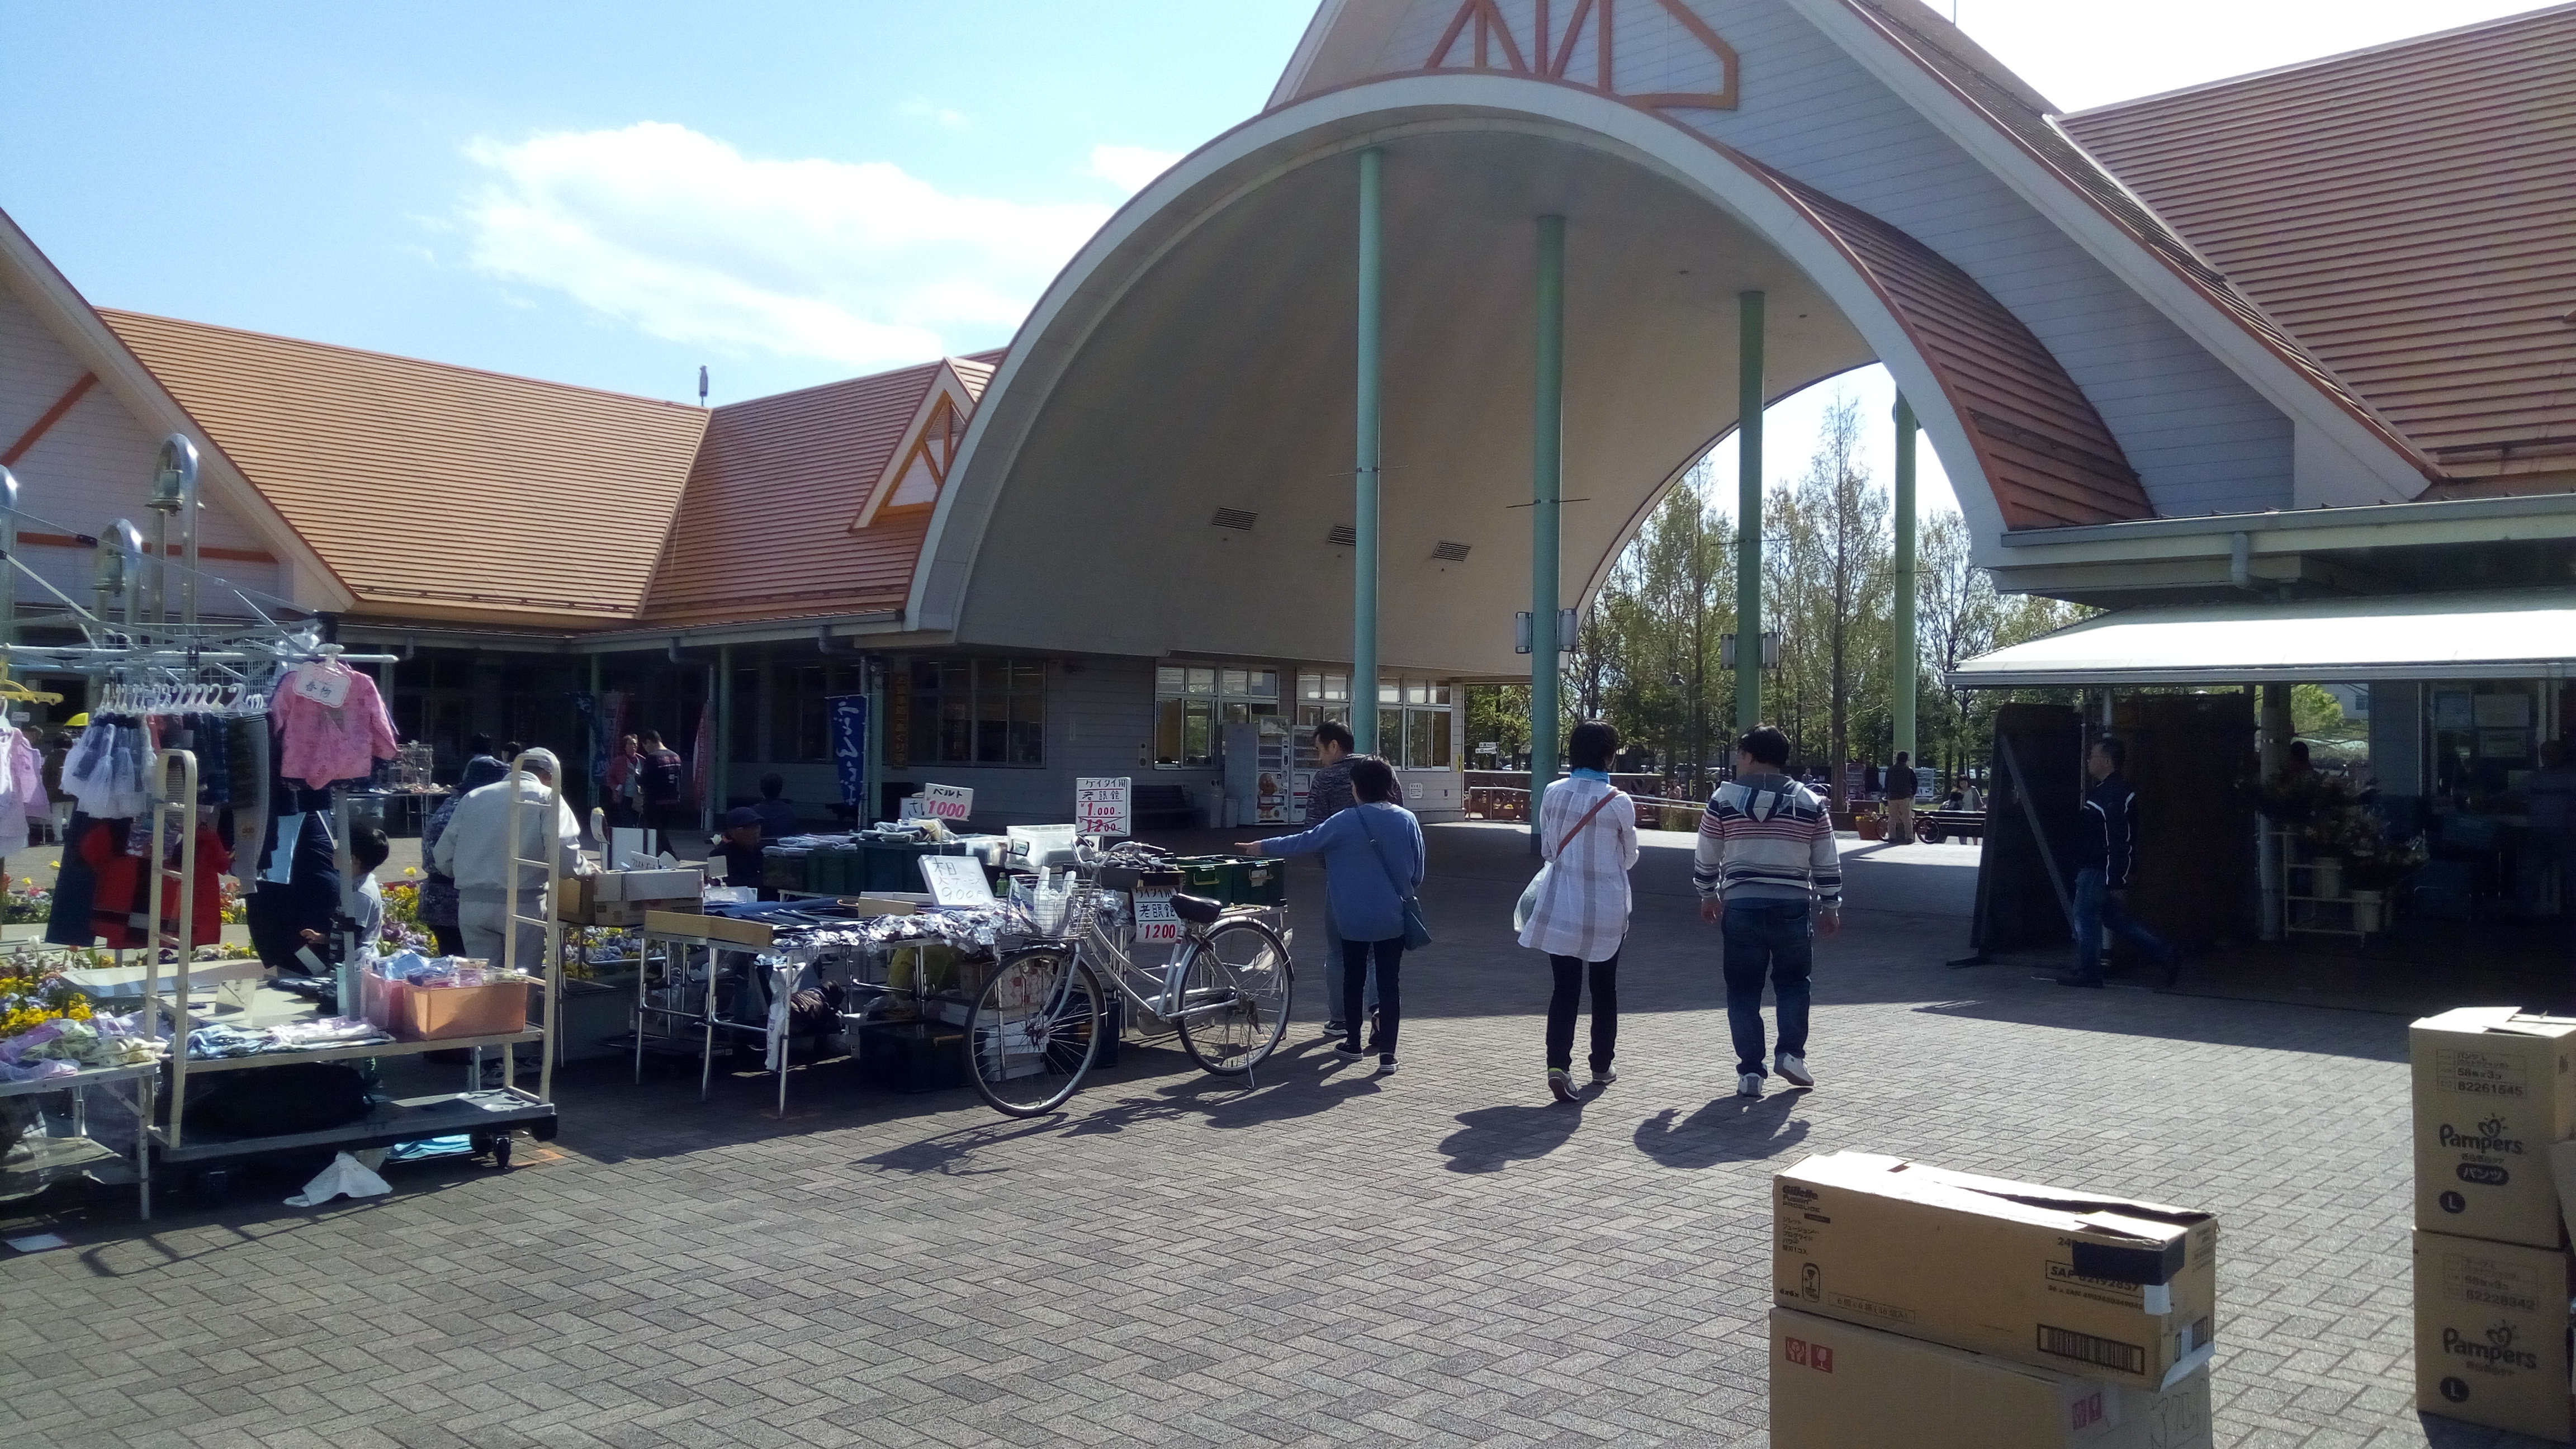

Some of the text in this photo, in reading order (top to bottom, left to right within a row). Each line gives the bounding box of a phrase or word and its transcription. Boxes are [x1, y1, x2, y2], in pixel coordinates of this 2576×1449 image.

[932, 788, 963, 798] ベルト
[2439, 1124, 2524, 1156] Pampers
[2463, 1167, 2502, 1181] パンツ
[1782, 1185, 1819, 1200] Gillette
[2448, 1194, 2457, 1209] L
[2050, 1266, 2076, 1278] SAP
[2066, 1289, 2081, 1298] EAN
[2442, 1327, 2538, 1370] Pampers
[2450, 1381, 2460, 1398] L
